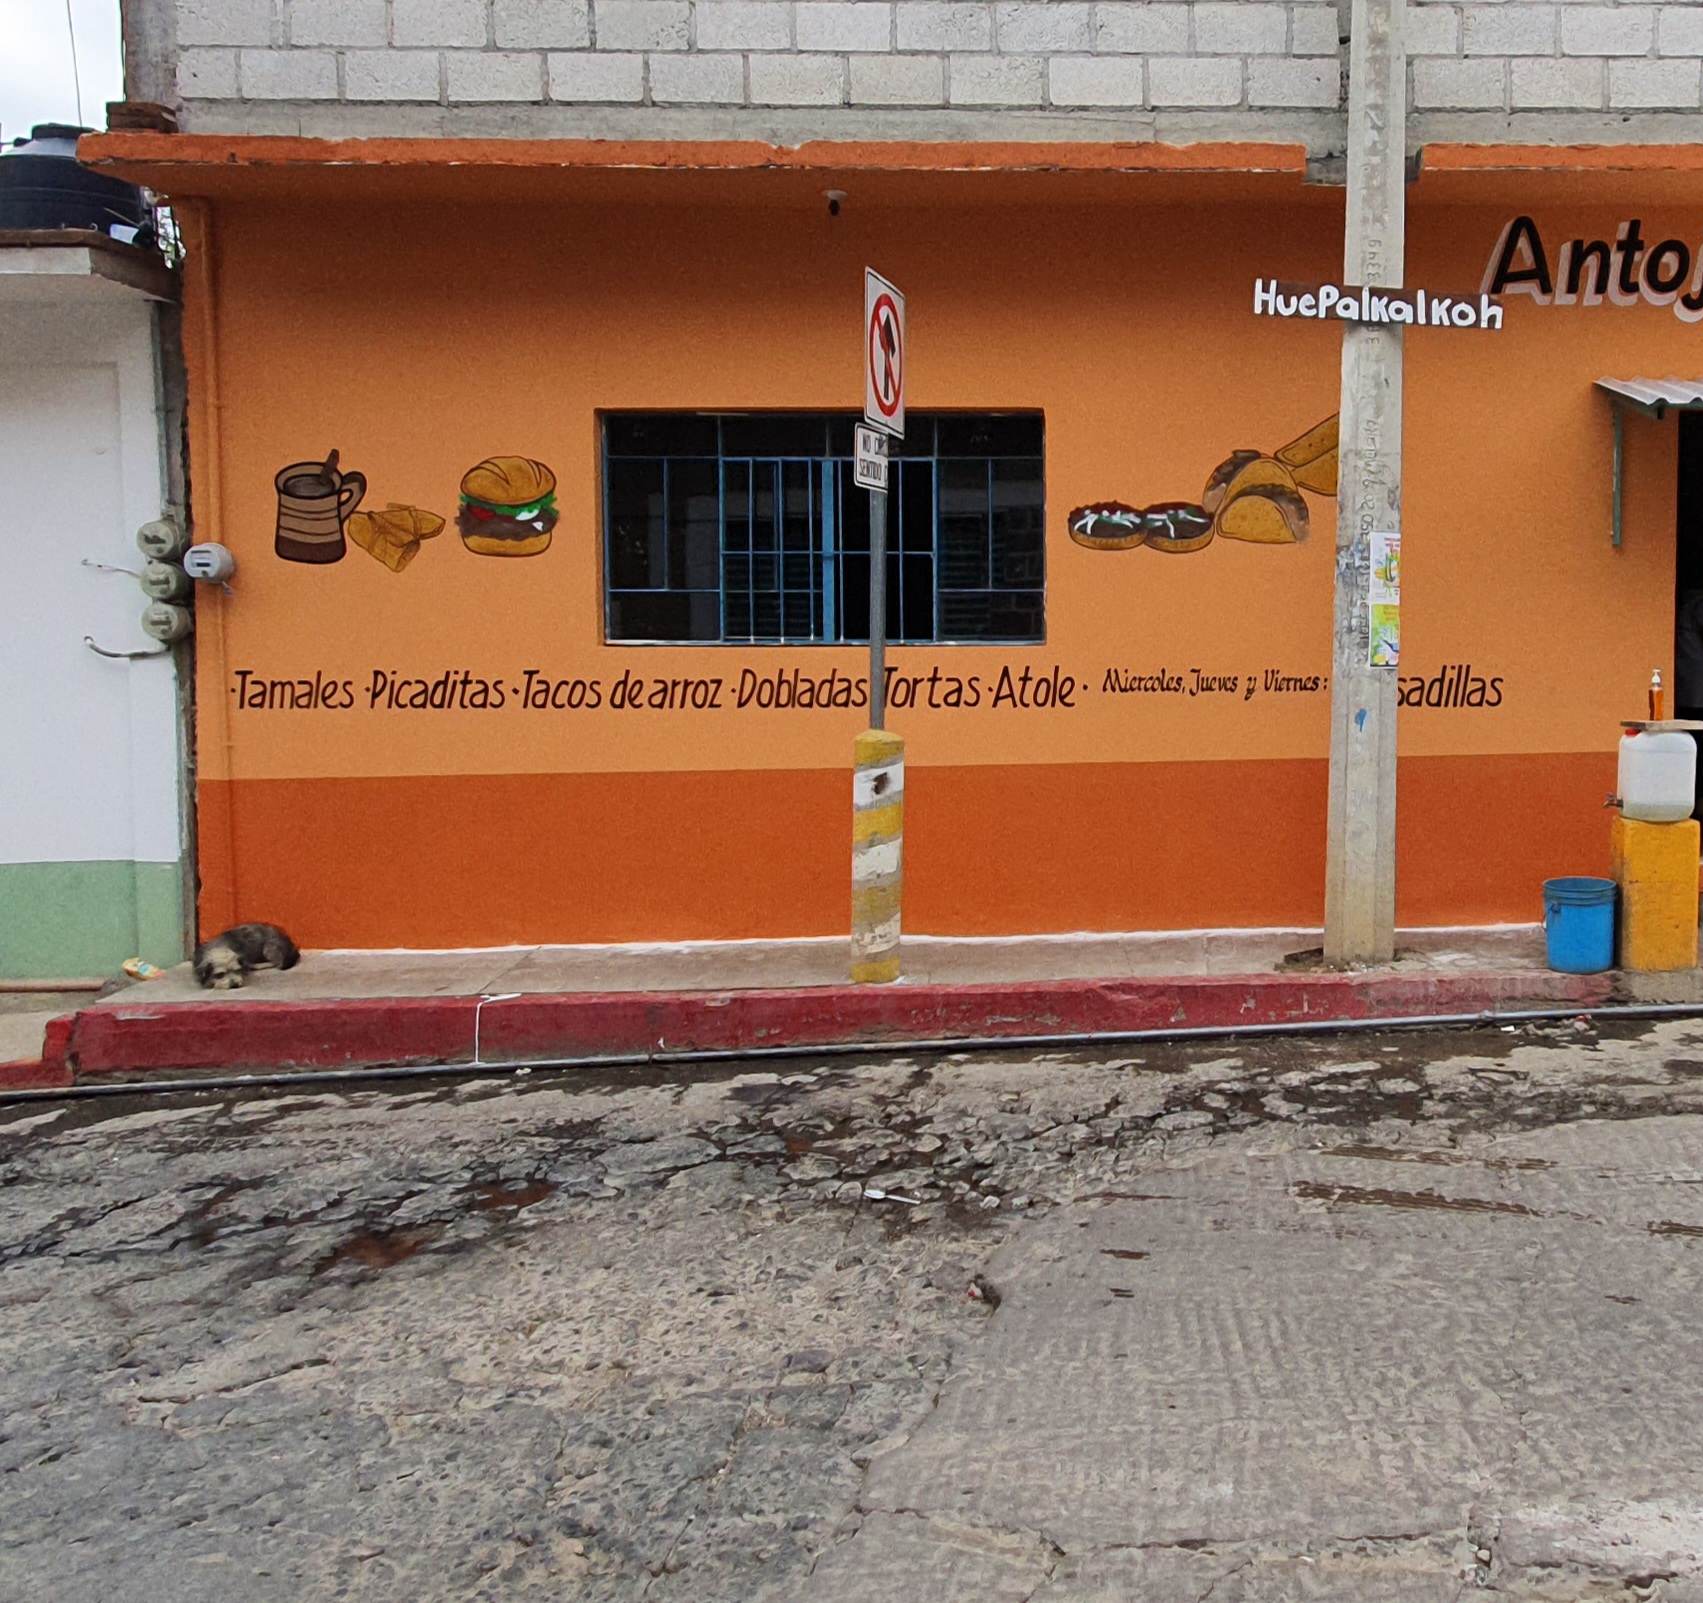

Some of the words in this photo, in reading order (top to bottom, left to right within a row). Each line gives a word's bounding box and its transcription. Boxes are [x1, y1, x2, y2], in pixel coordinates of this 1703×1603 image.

[609, 670, 644, 709] de
[647, 678, 723, 709] arroz
[885, 666, 981, 708] Tortas
[1188, 668, 1239, 697] Jueves
[1244, 677, 1257, 701] y
